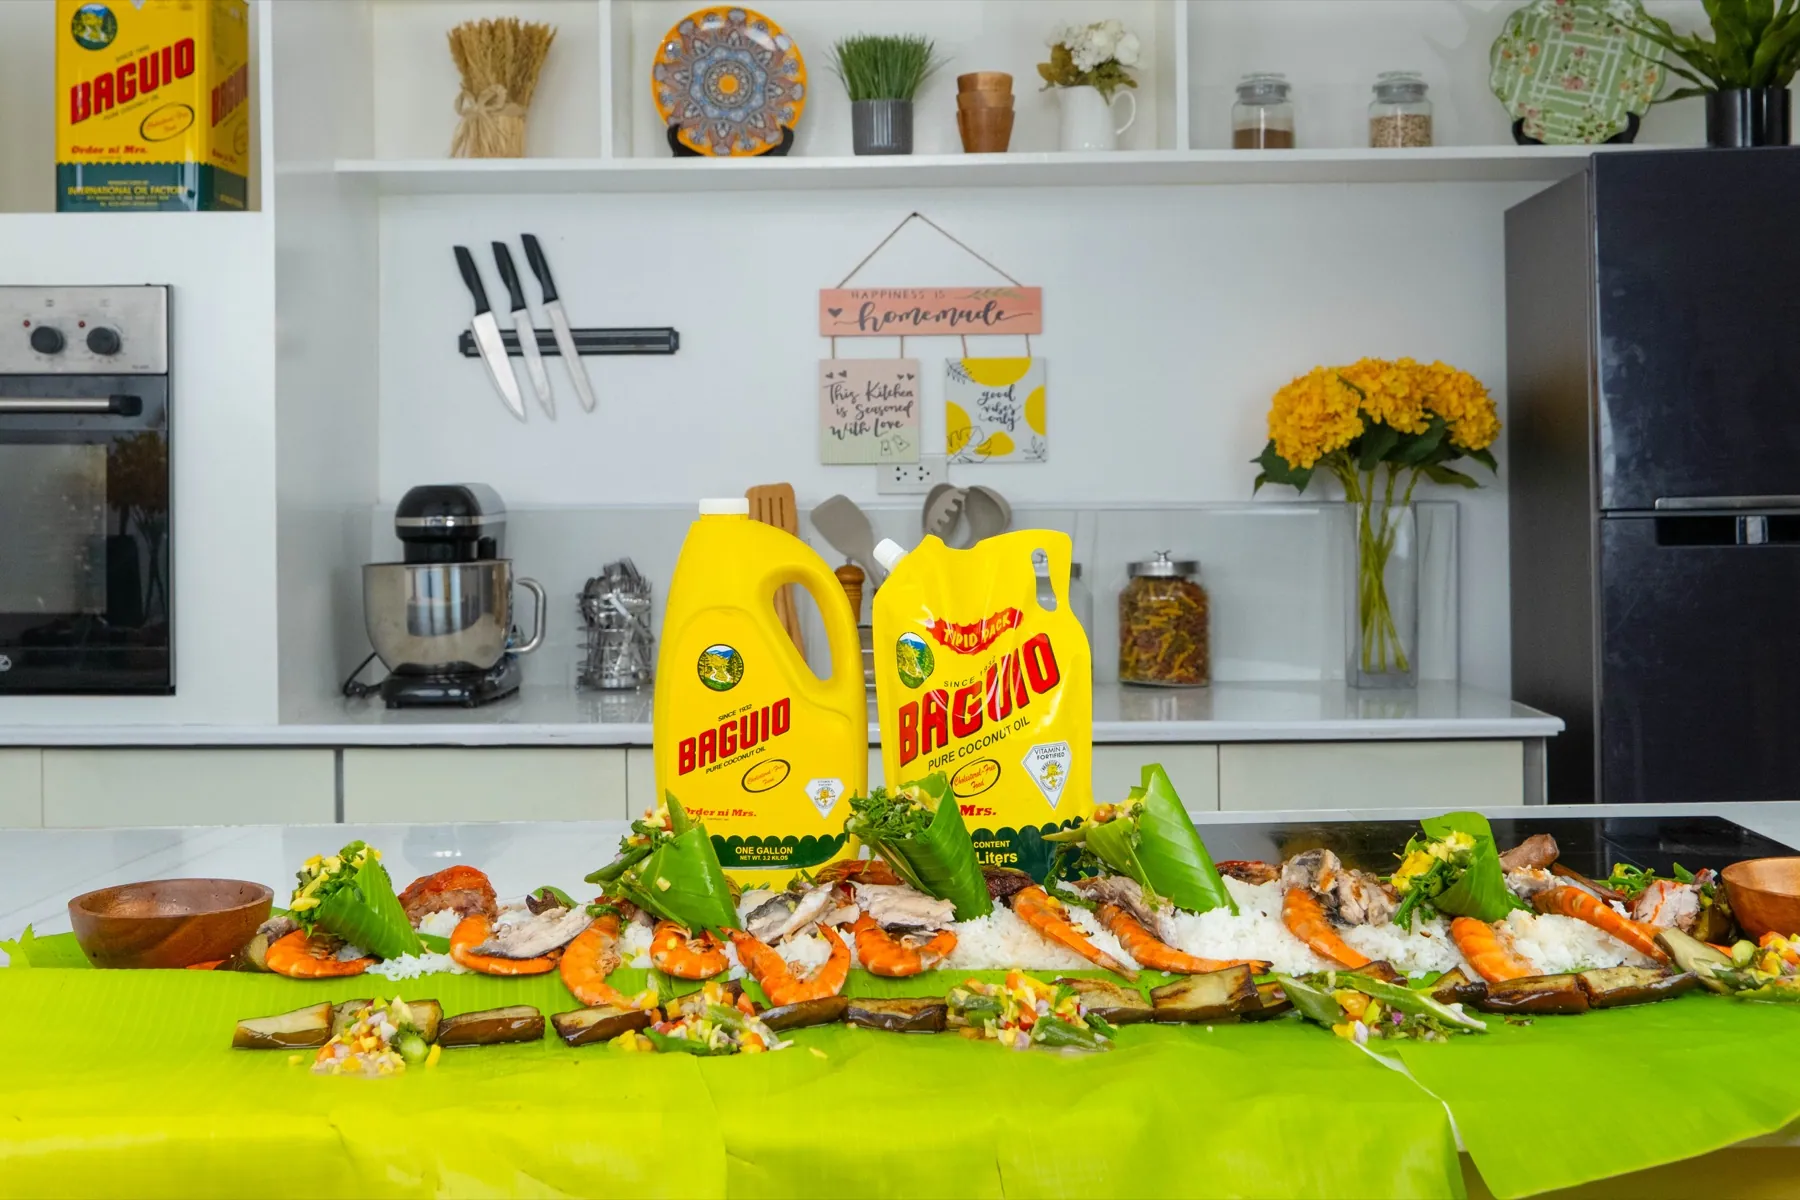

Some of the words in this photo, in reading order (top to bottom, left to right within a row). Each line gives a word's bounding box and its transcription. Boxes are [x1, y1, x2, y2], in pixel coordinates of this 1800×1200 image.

[71, 37, 195, 125] BAGUIO
[70, 145, 104, 155] Order
[851, 290, 925, 300] HAPPINESS
[934, 290, 946, 299] IS
[834, 300, 1033, 332] homemade
[823, 380, 860, 405] This
[865, 380, 914, 401] Kitchen
[977, 384, 1016, 406] good
[836, 404, 848, 418] is
[983, 402, 1021, 417] vibes
[874, 418, 904, 437] Love
[979, 415, 1021, 432] only
[943, 628, 978, 648] TIPID
[982, 612, 1011, 643] PACK
[943, 676, 975, 688] SINCE
[899, 632, 1060, 768] BAGUIO
[718, 710, 737, 722] SINCE
[739, 704, 753, 713] 1932
[679, 697, 790, 776] BAGUIO
[928, 751, 955, 771] PURE
[958, 725, 1012, 758] COCONUT
[1013, 716, 1031, 732] OIL
[1034, 746, 1061, 755] VITAMIN
[1036, 752, 1065, 761] FORTIFIED
[705, 764, 723, 775] PURE
[723, 750, 755, 767] COCONUT
[755, 746, 767, 755] OIL
[970, 779, 985, 792] Food
[716, 808, 730, 817] ni
[731, 808, 757, 817] Mrs.
[960, 804, 997, 817] Mrs.
[735, 846, 754, 855] ONE
[756, 846, 793, 855] GALLON
[973, 840, 1011, 849] CONTENT
[976, 851, 1018, 865] Liters
